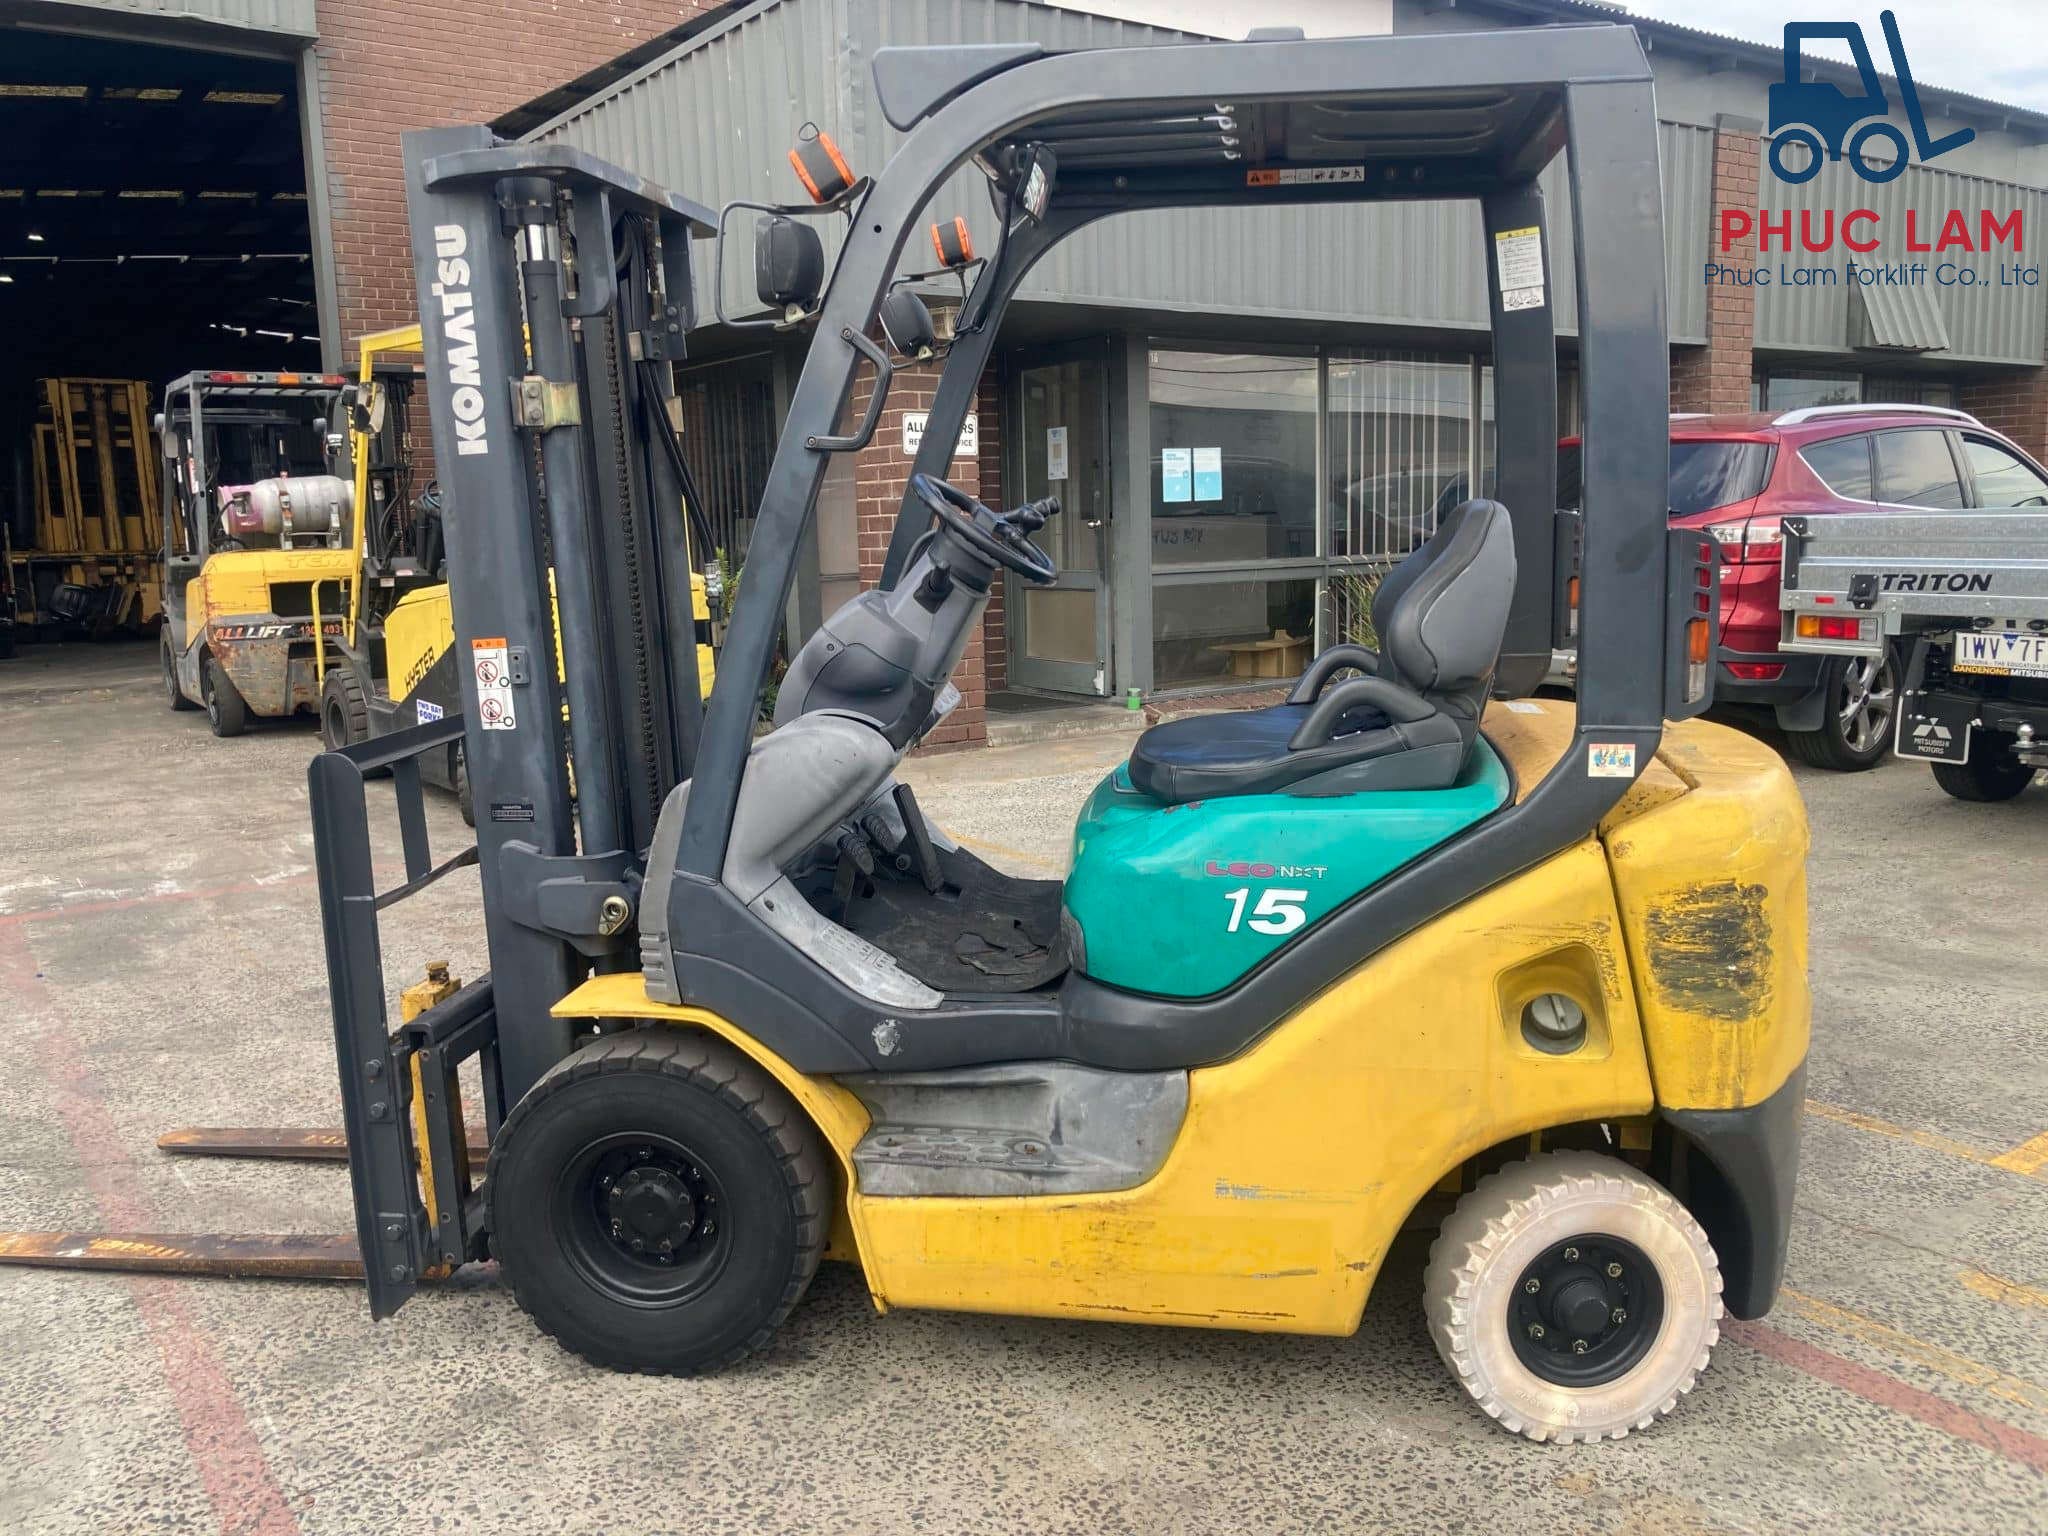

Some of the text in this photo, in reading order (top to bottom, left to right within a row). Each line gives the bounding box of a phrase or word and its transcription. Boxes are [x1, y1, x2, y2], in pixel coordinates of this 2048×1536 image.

[431, 224, 488, 455] KOMATSU
[907, 421, 924, 432] ALL
[287, 553, 349, 569] TCM
[1882, 574, 1993, 591] TRITON
[1962, 636, 2001, 660] 1WV
[404, 646, 437, 693] HYSTER
[1953, 665, 2009, 675] DANDENONG
[1914, 738, 1950, 747] MITSUBISHI
[1918, 746, 1944, 754] MOTORS
[1224, 888, 1308, 935] 15
